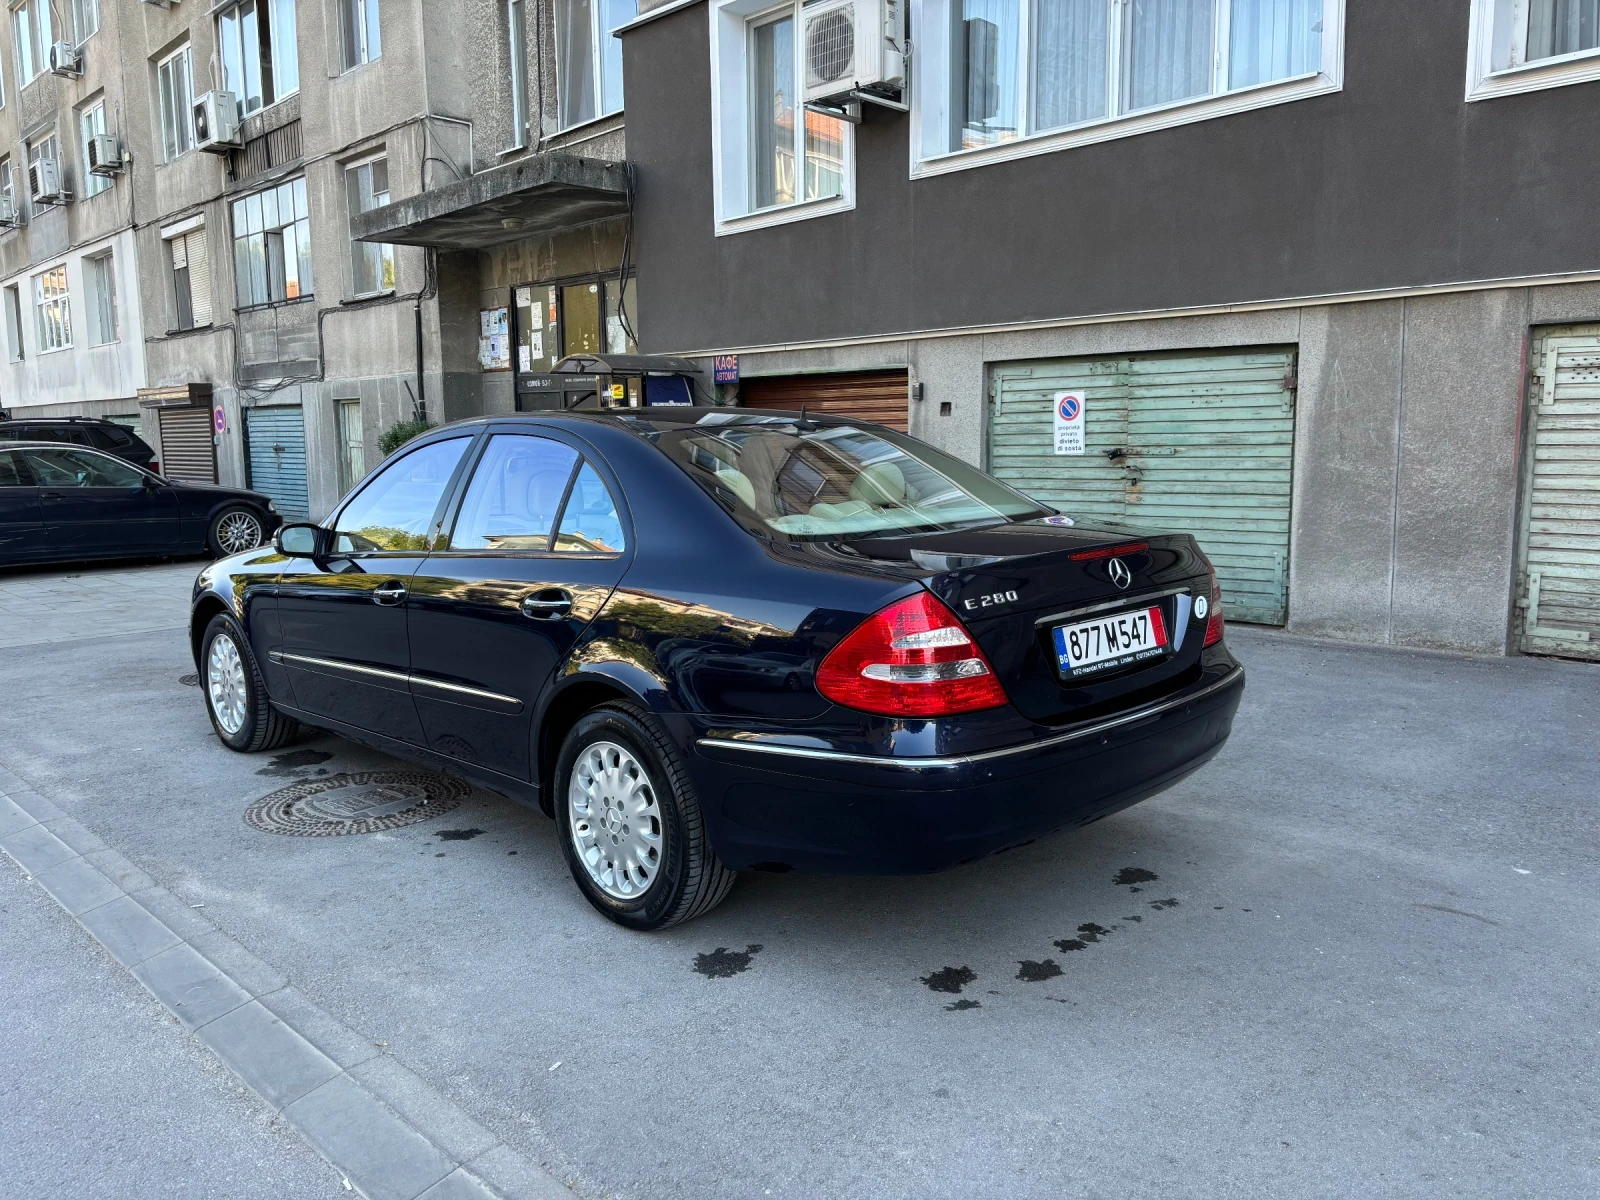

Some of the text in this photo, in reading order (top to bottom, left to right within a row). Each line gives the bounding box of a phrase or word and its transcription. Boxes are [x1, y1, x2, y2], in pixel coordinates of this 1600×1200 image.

[715, 355, 738, 371] КАФЕ
[716, 371, 737, 381] АВТОМАТ
[964, 590, 1019, 610] E 280
[1198, 598, 1204, 615] D
[1069, 625, 1101, 661] 877
[1059, 654, 1069, 664] BG
